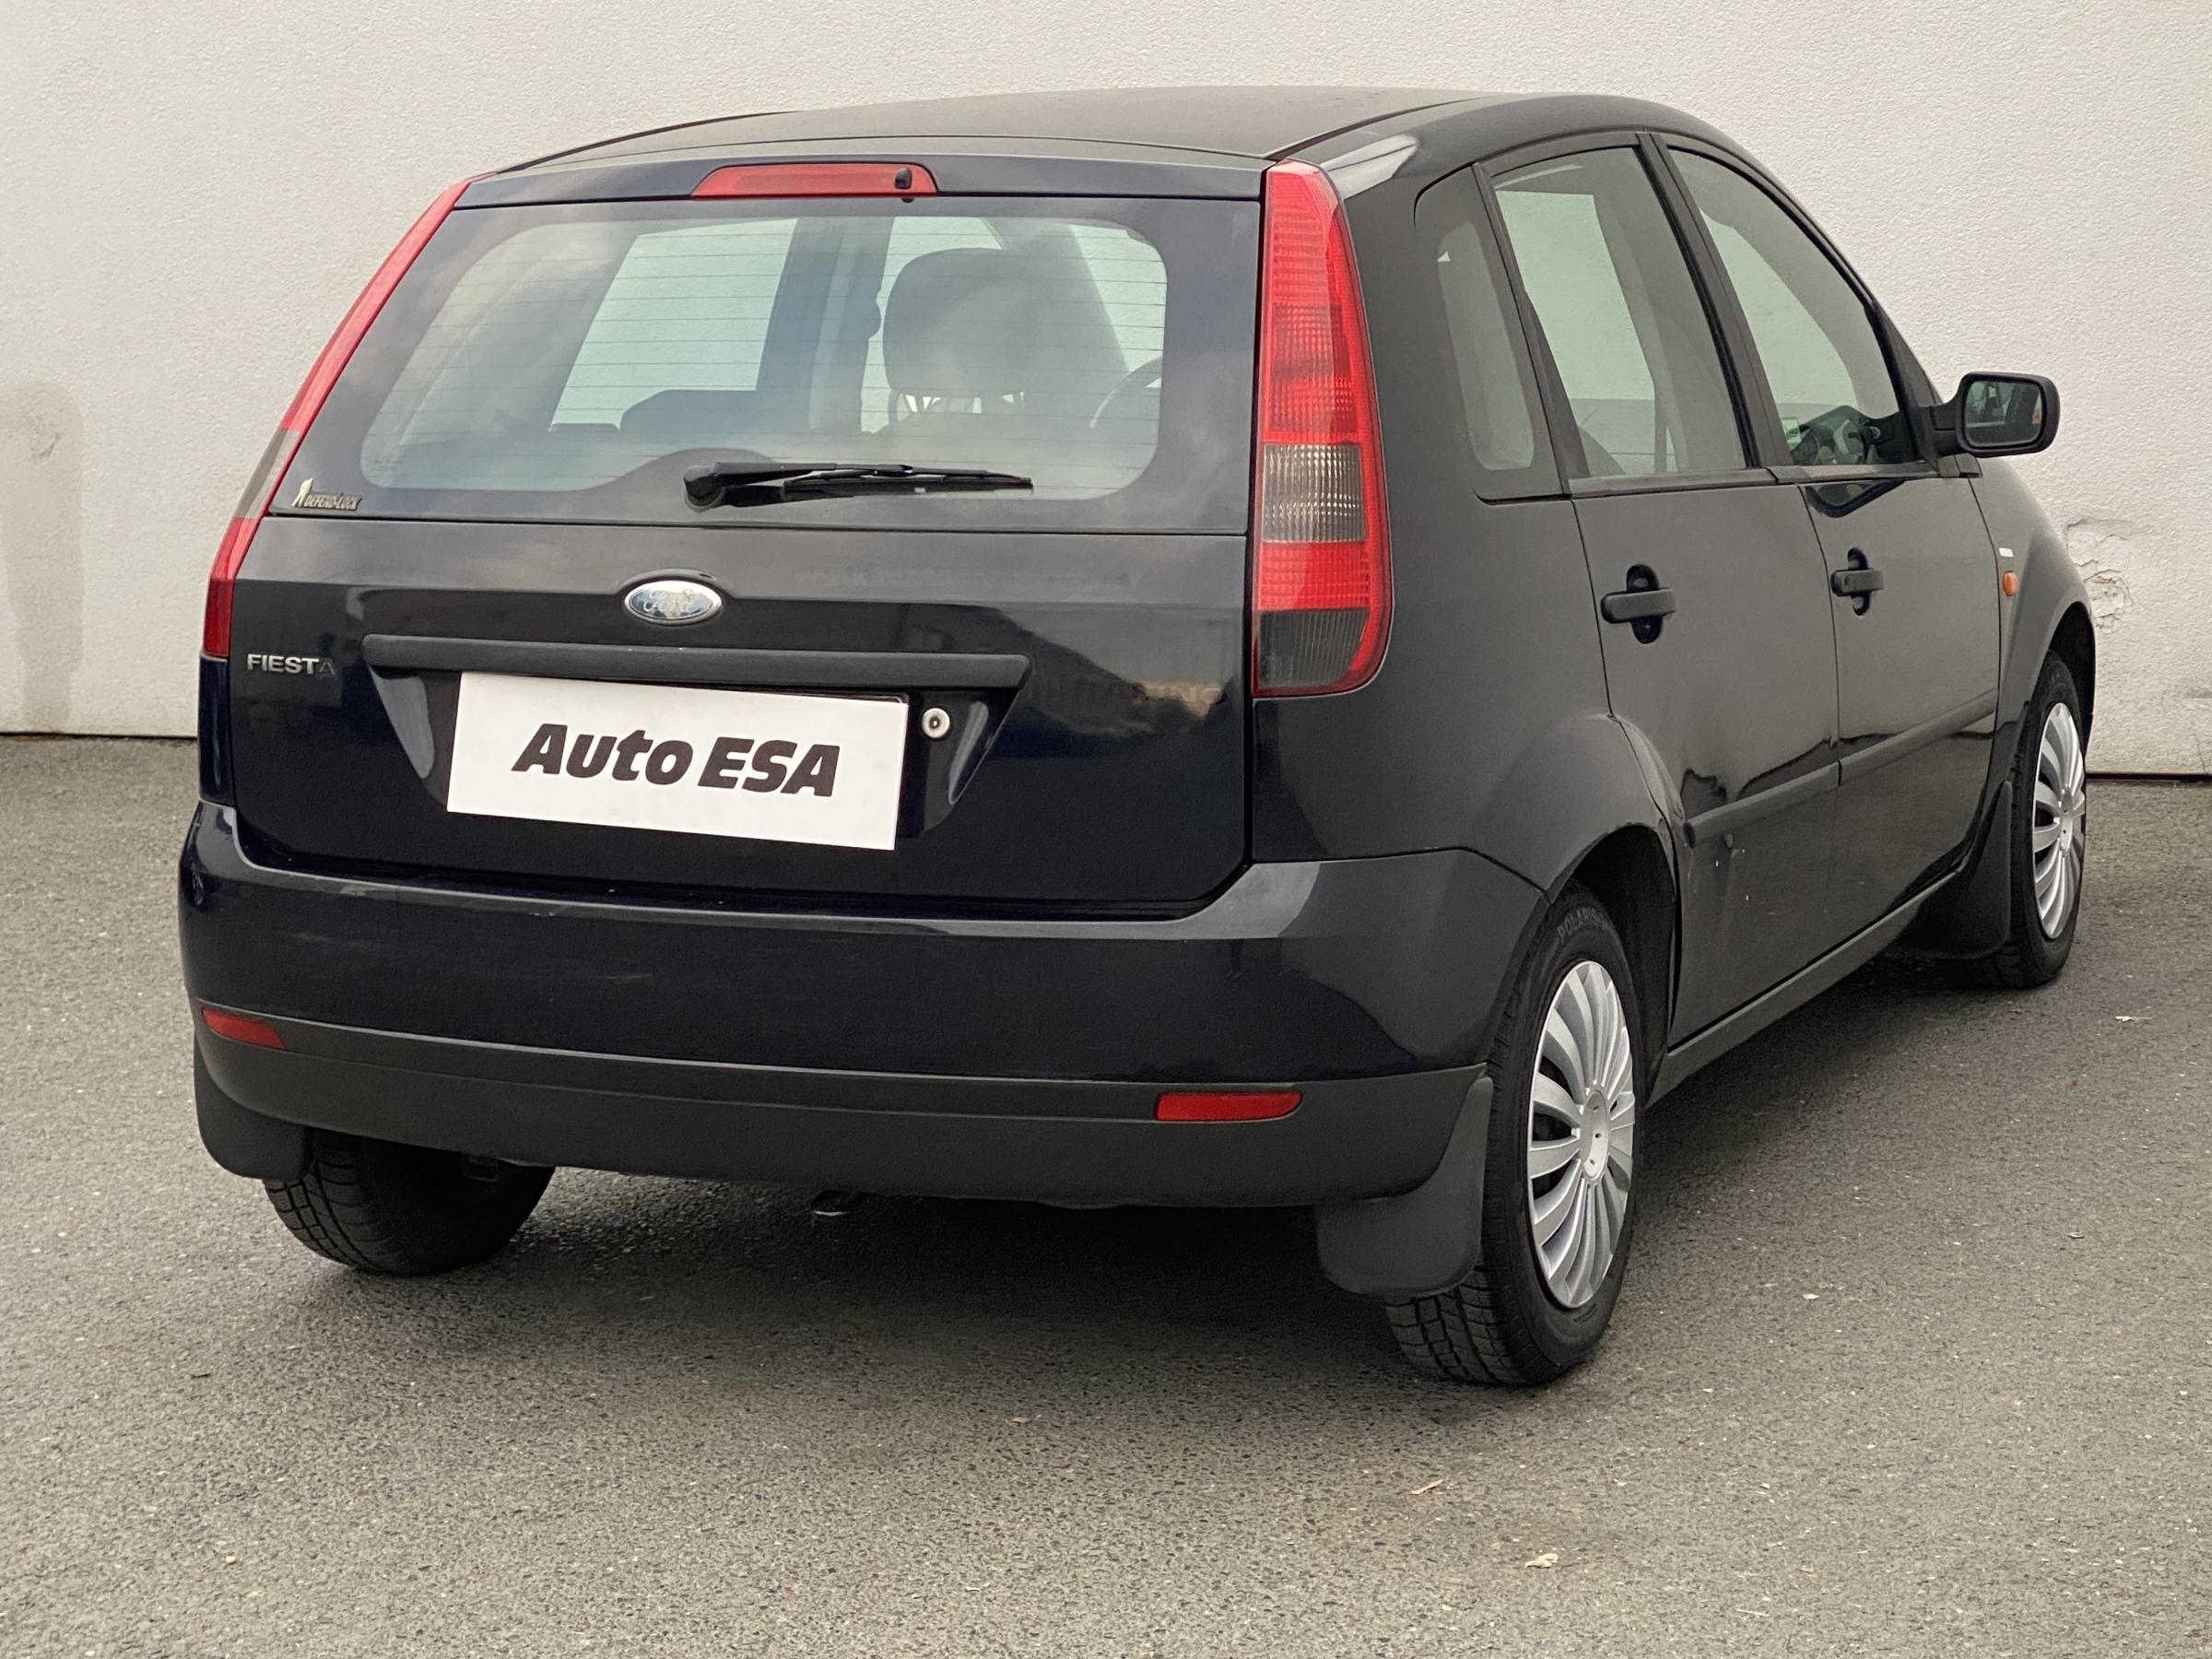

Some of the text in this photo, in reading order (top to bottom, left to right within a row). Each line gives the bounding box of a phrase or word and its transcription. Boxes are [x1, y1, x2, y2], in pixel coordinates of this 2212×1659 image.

[247, 653, 336, 675] FIESTA
[511, 723, 841, 797] Auto ESA
